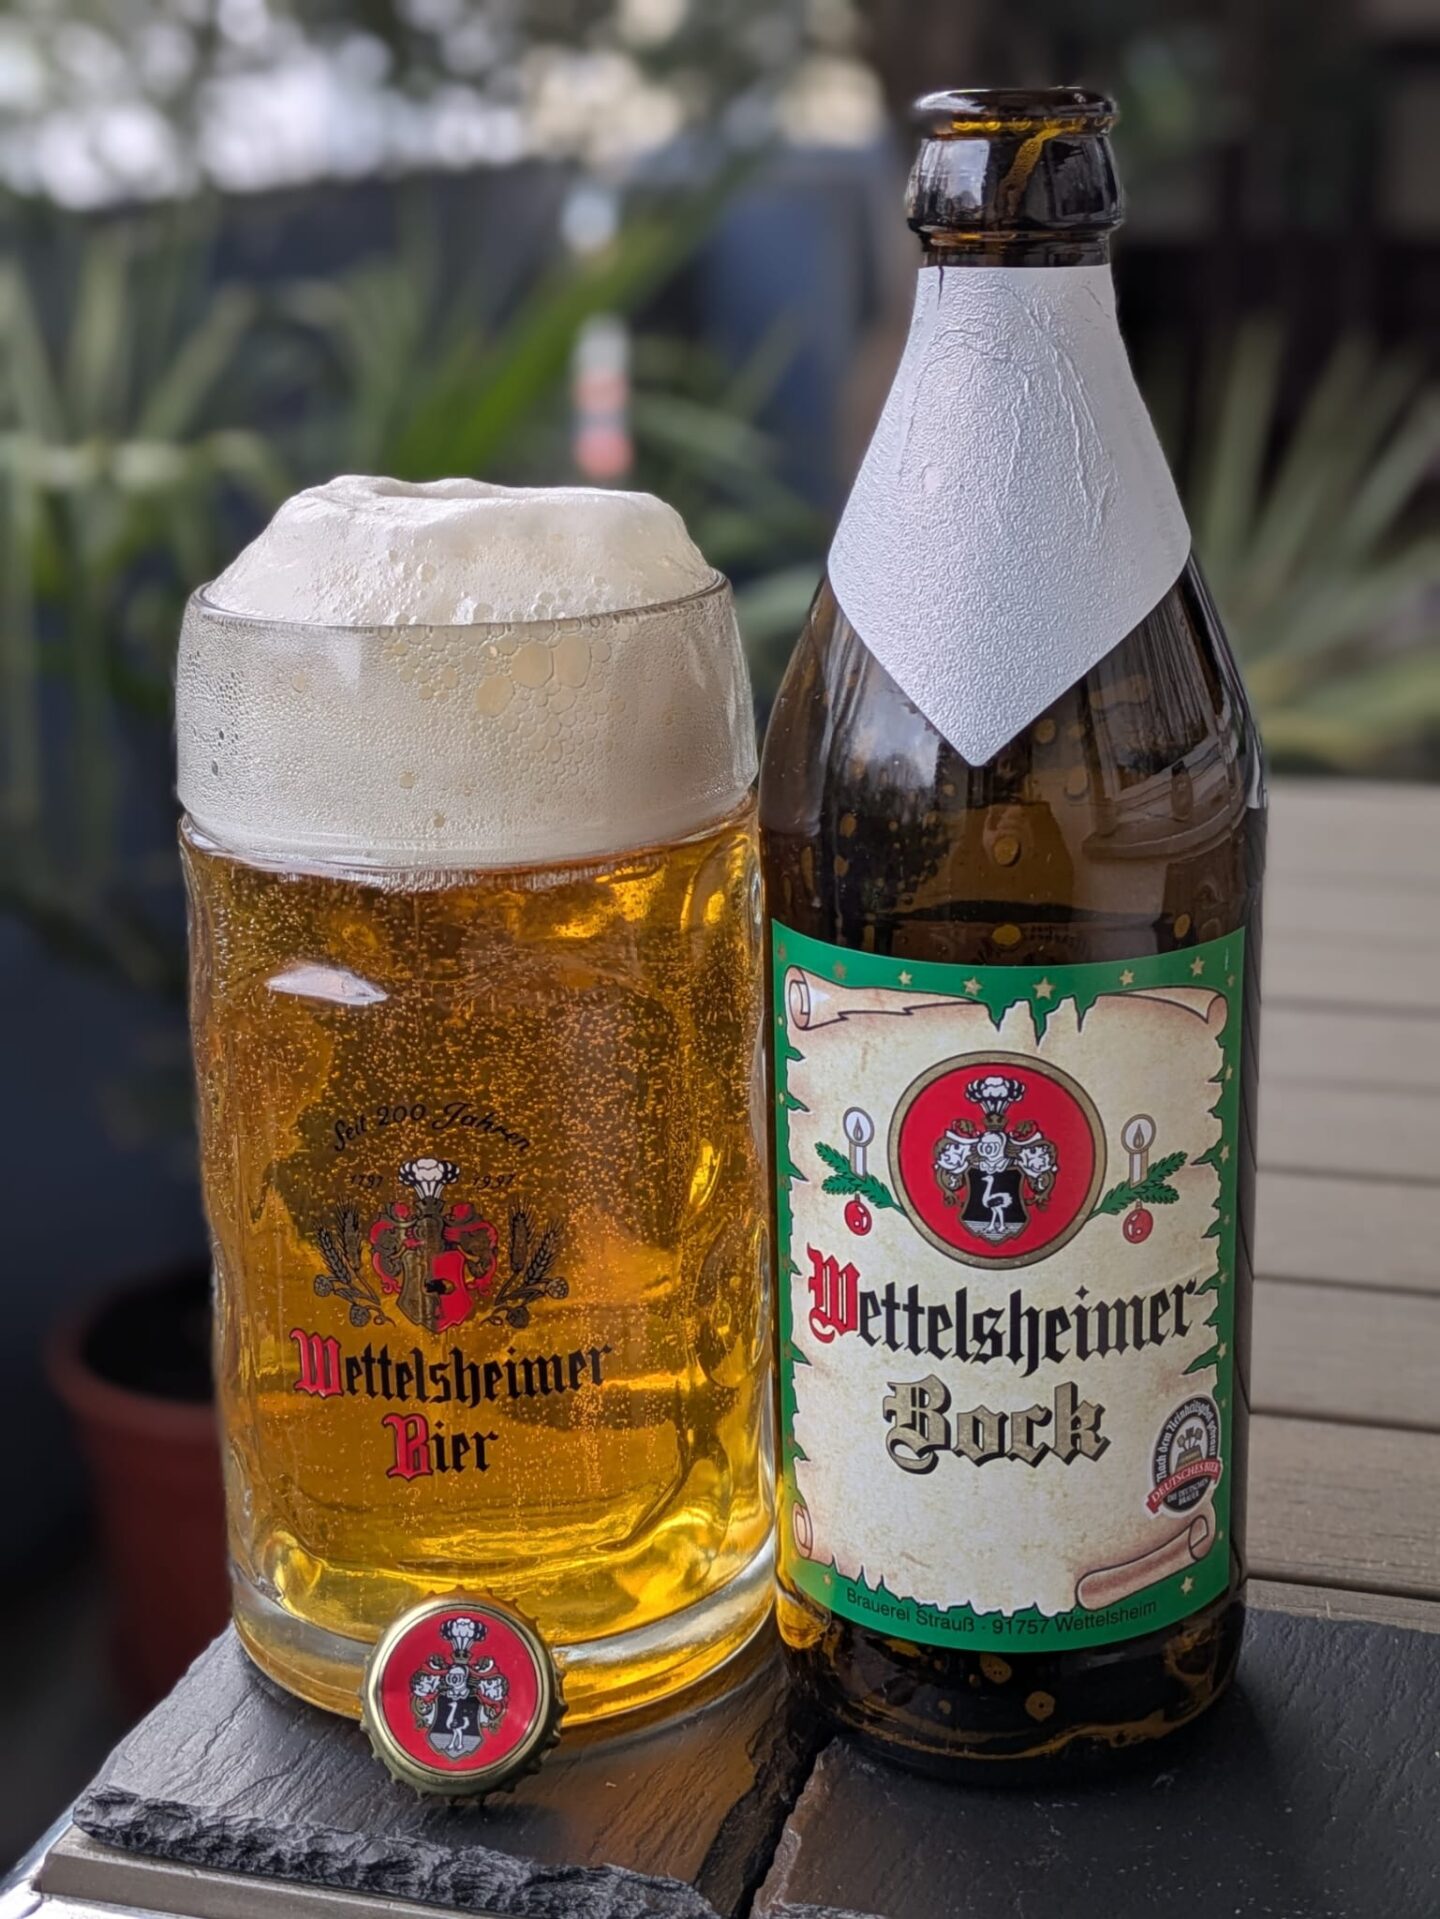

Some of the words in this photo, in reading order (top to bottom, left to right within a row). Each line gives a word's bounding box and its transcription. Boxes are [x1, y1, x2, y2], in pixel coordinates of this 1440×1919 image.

[376, 1103, 427, 1127] 200
[431, 1101, 532, 1152] Jahren
[806, 1242, 1198, 1378] Wettelsheimer
[290, 1327, 614, 1409] Wettelsheimer
[381, 1411, 500, 1482] Bier
[881, 1374, 1112, 1475] Bock
[1151, 1461, 1205, 1503] DEUTSCHES
[846, 1587, 911, 1623] Brauerei
[915, 1608, 975, 1632] Strauß
[991, 1616, 1050, 1635] 91757
[1052, 1599, 1158, 1633] Wettelsheim
